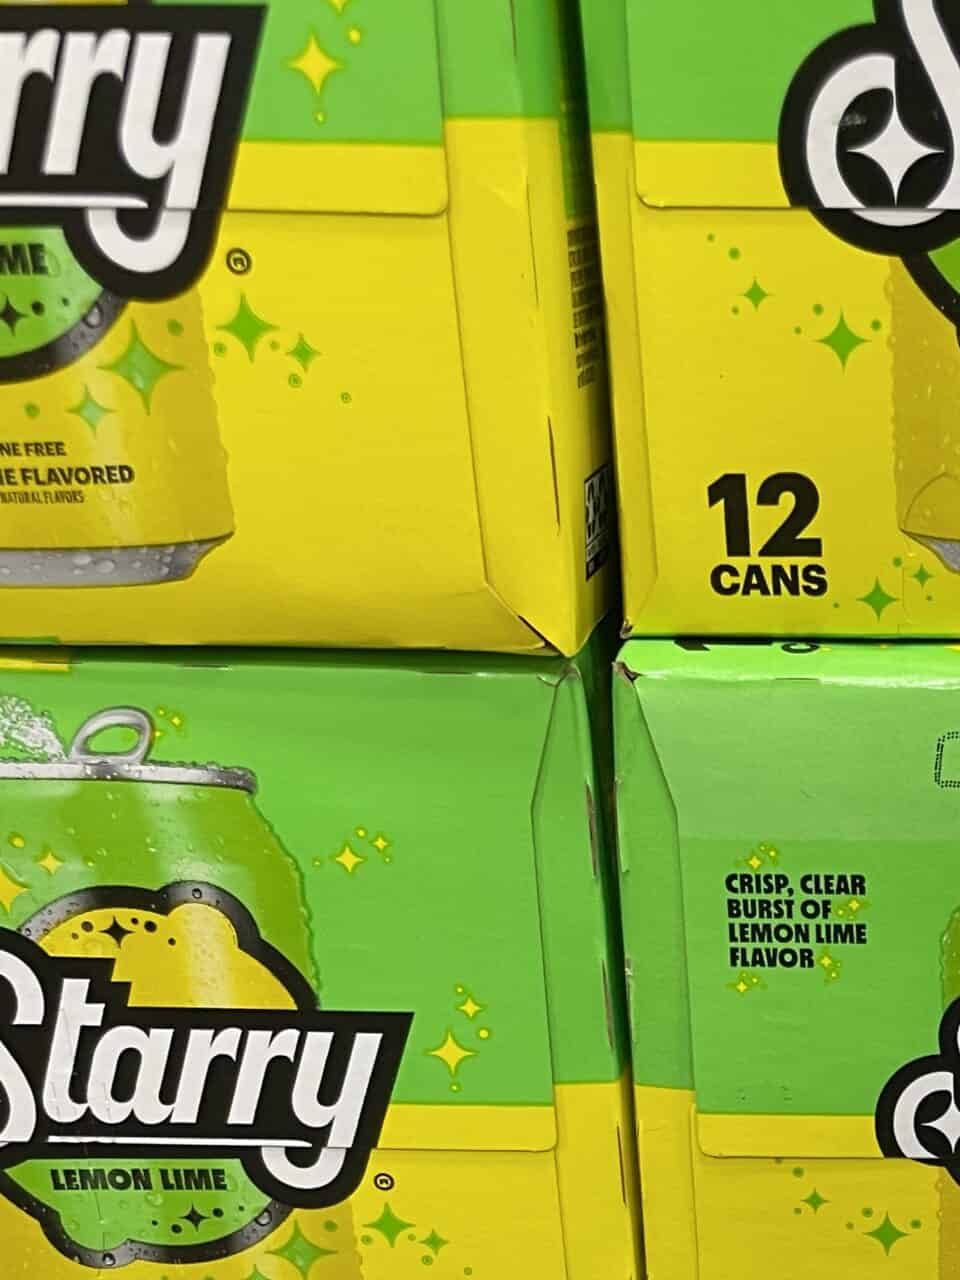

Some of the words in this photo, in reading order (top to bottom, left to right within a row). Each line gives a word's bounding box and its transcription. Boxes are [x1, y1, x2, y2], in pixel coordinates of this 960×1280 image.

[24, 441, 67, 457] FREE
[21, 464, 136, 487] FLAVORED
[707, 471, 823, 558] 12
[710, 563, 829, 597] CANS
[725, 873, 795, 897] CRISP,
[800, 873, 866, 896] CLEAR
[727, 898, 795, 920] BURST
[800, 898, 832, 920] OF
[728, 922, 810, 944] LEMON
[815, 923, 867, 944] LIME
[730, 947, 815, 968] FLAVOR
[50, 1168, 154, 1192] LEMON
[161, 1168, 228, 1192] LIME
